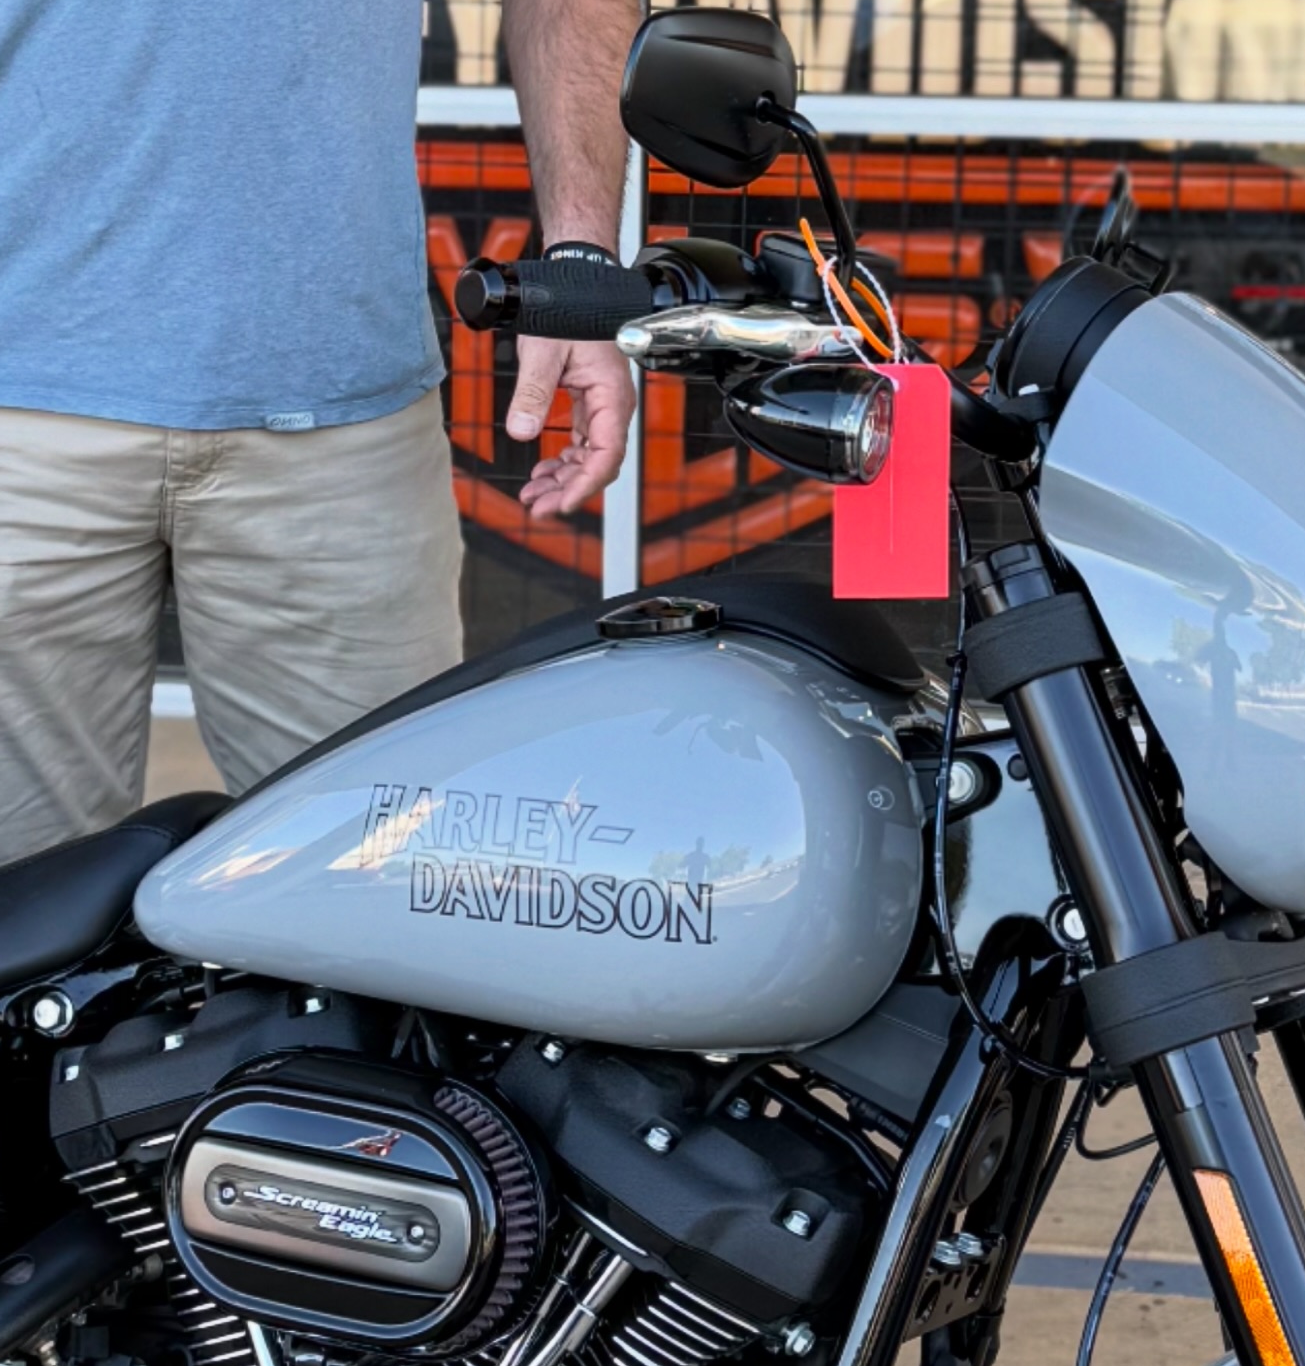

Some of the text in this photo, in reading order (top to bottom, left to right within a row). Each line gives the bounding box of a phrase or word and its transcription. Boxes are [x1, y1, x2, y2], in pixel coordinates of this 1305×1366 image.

[358, 783, 635, 867] HARLEY-
[409, 851, 714, 945] DAVIDSON
[319, 1214, 398, 1243] Eagle
